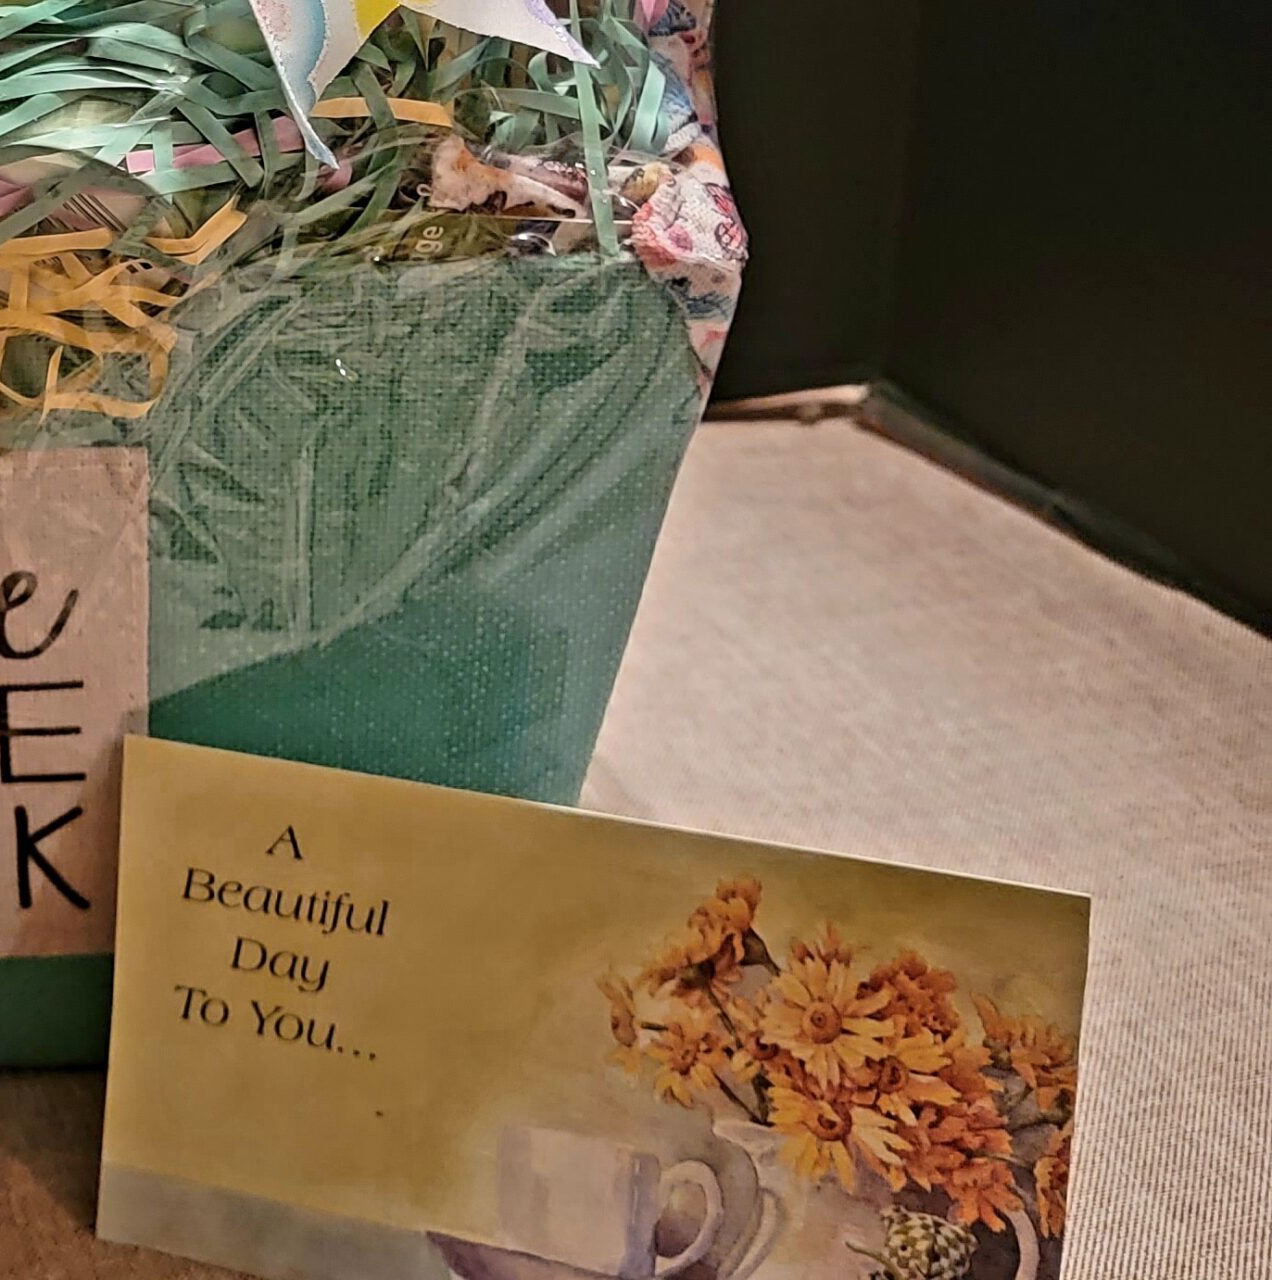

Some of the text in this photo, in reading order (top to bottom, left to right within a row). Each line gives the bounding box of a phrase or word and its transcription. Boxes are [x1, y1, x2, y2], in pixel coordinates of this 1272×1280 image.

[265, 824, 303, 860] A
[182, 867, 389, 936] Beautiful
[231, 936, 330, 993] Day
[174, 984, 377, 1060] To You...
